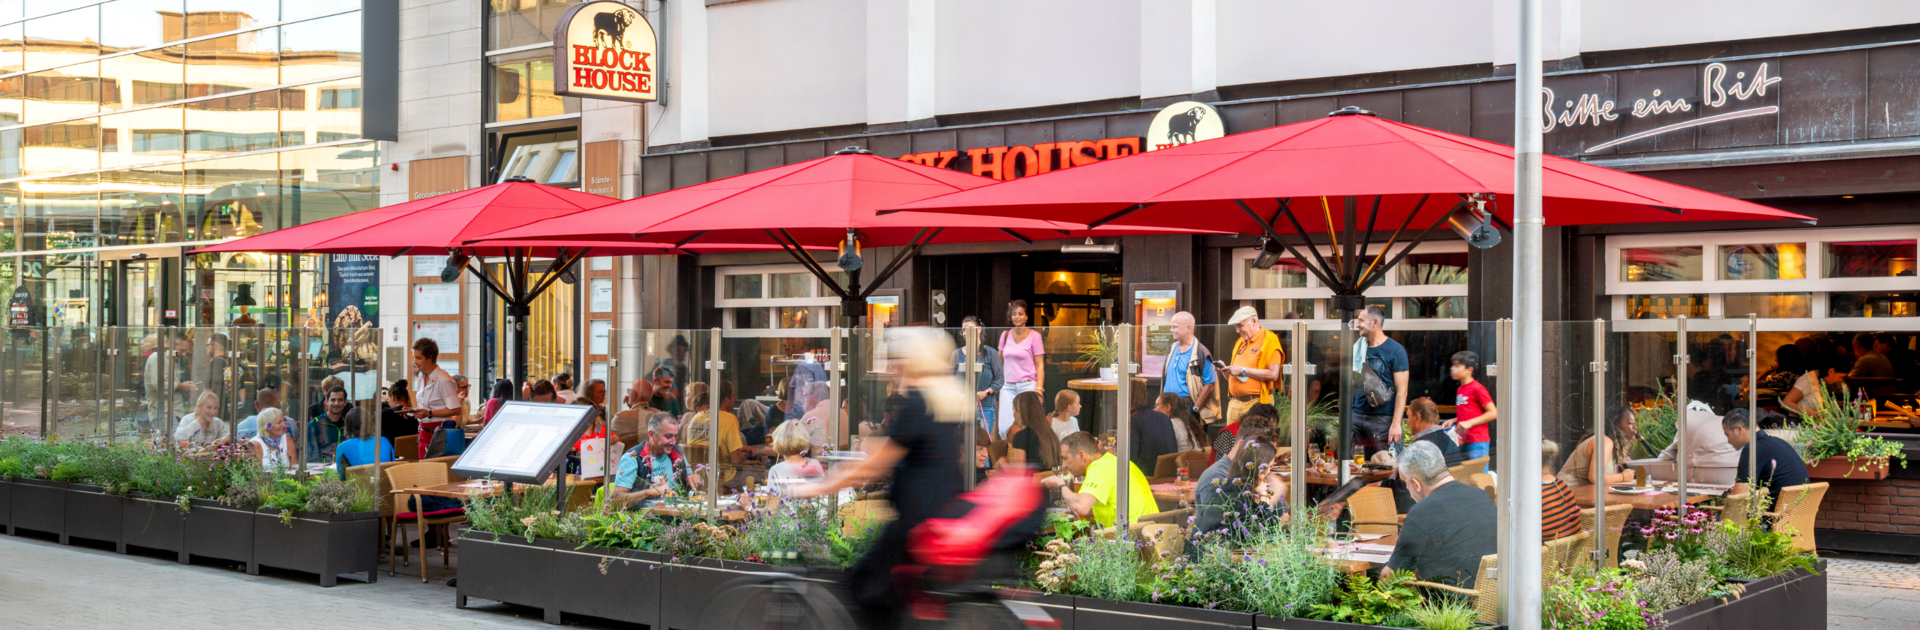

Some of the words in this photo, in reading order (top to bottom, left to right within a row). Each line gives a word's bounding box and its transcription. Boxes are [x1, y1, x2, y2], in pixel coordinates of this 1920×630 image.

[573, 44, 651, 72] BLOCK
[573, 67, 651, 93] HOUSE
[1542, 87, 1618, 133] Bitte
[1632, 89, 1691, 118] ein
[1704, 63, 1782, 108] Bit
[967, 136, 1140, 181] HOUSE
